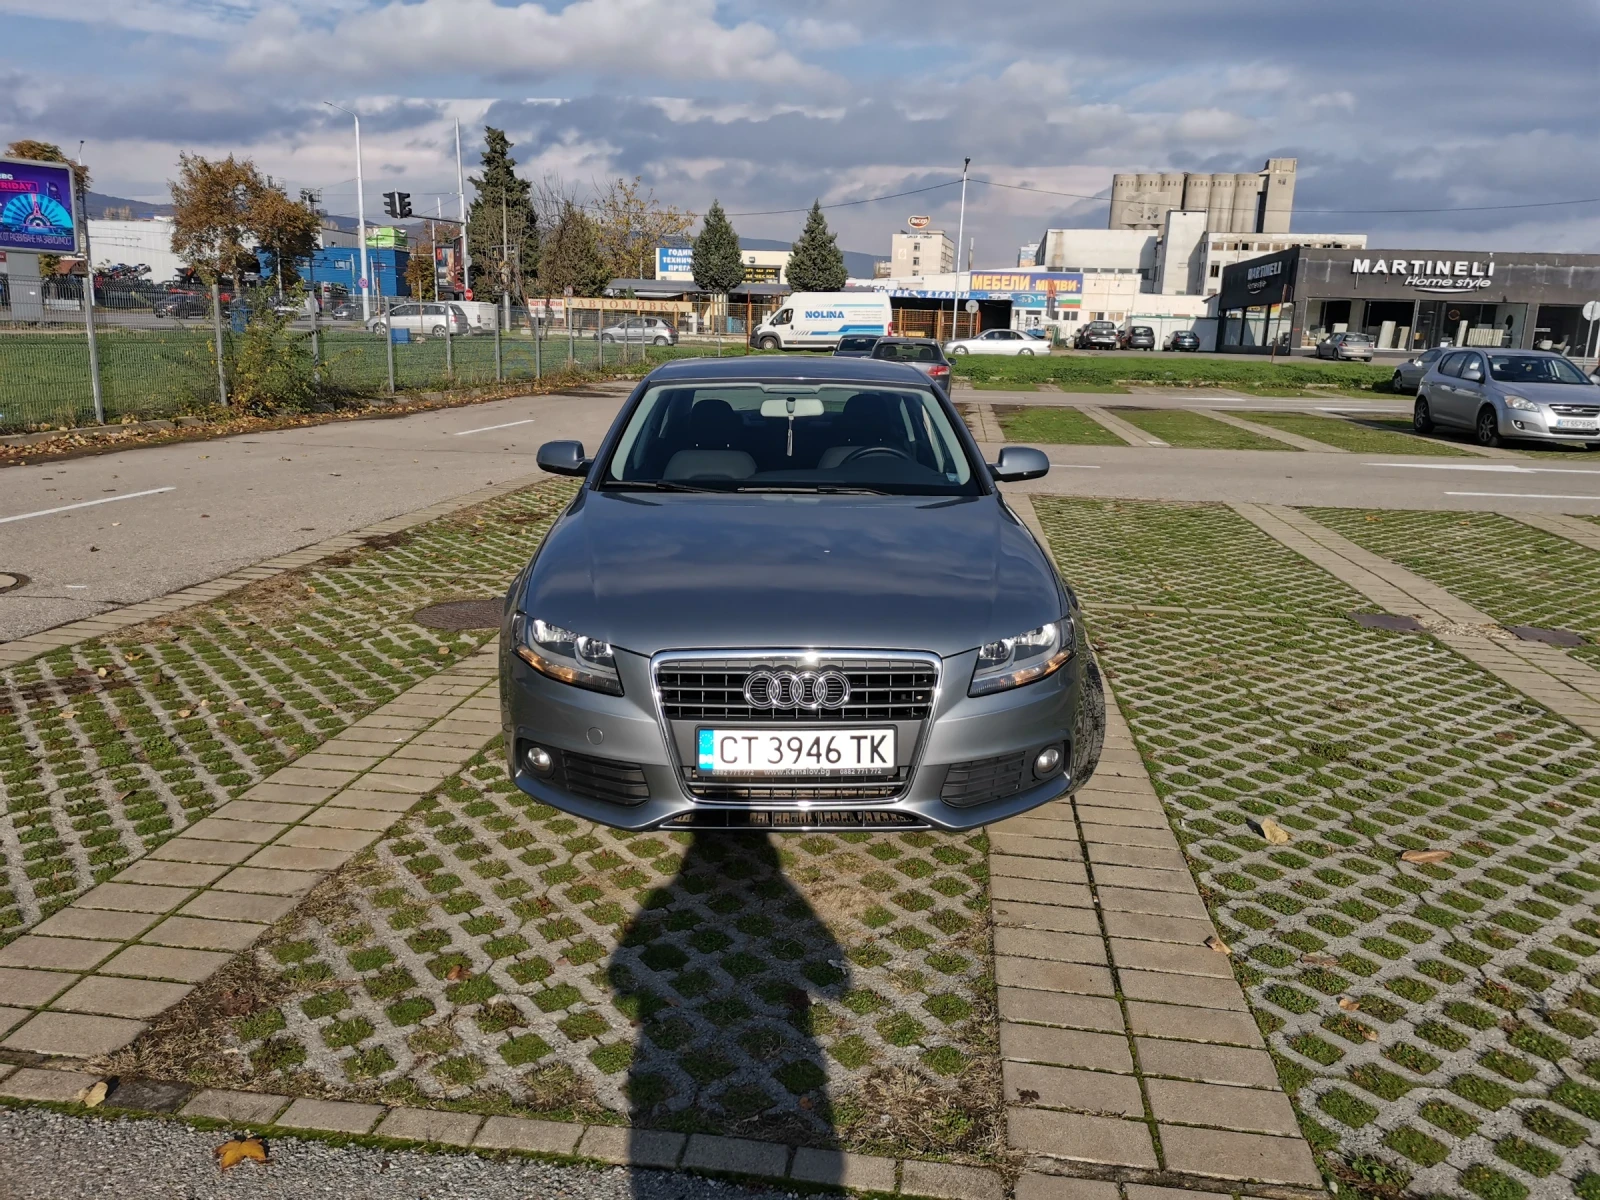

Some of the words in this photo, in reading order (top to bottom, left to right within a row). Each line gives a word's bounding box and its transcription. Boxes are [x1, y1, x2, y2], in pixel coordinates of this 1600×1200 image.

[0, 181, 32, 191] RIDAY
[1352, 258, 1496, 277] MARTINELI
[971, 274, 1031, 291] МЕБЕЛИ
[1404, 275, 1453, 287] Home
[1456, 277, 1492, 289] style
[577, 300, 681, 311] АВТОМИВКА
[805, 311, 845, 319] NOLINA
[720, 736, 759, 764] CT
[767, 736, 842, 764] 3946
[850, 735, 887, 764] TK
